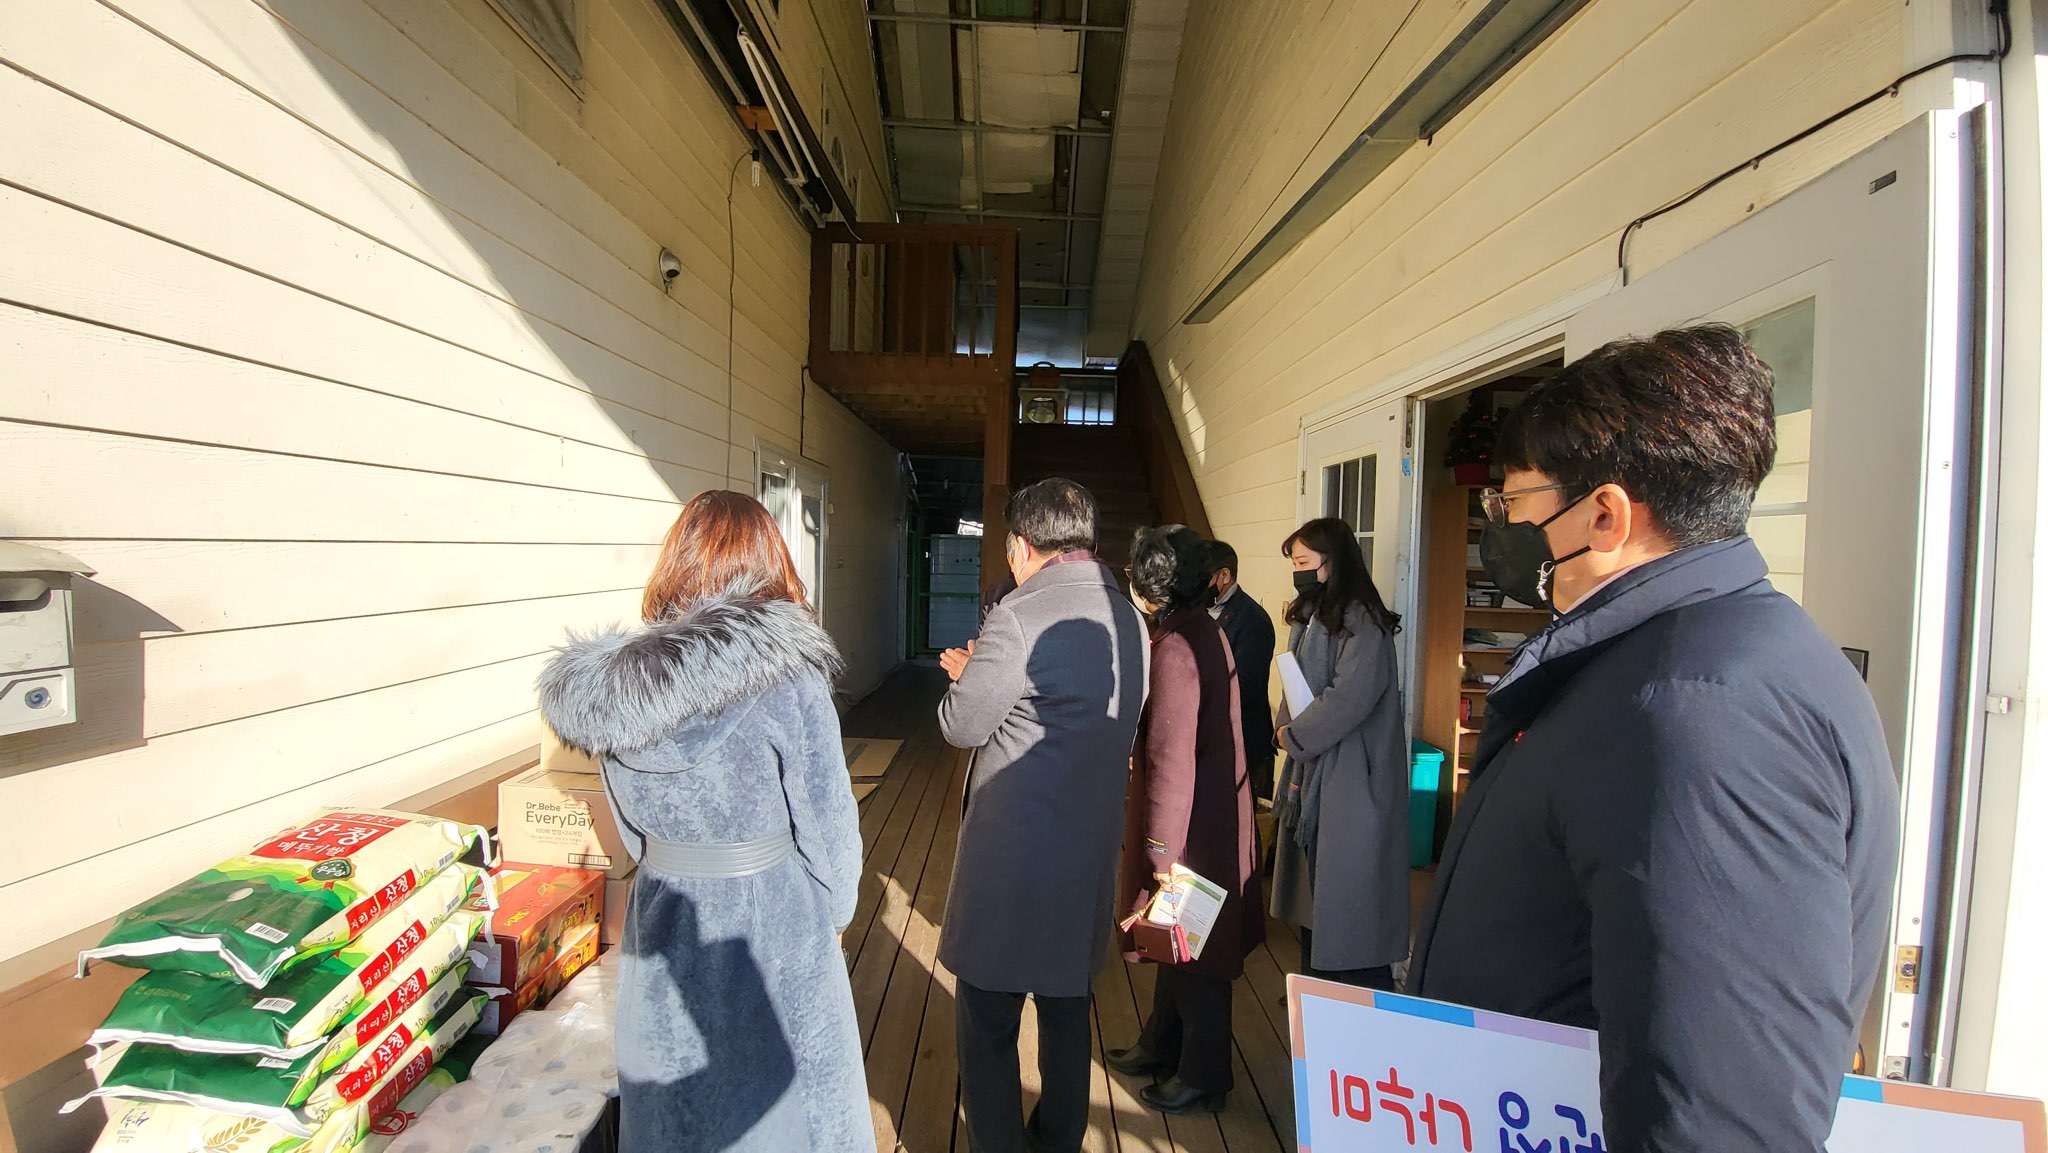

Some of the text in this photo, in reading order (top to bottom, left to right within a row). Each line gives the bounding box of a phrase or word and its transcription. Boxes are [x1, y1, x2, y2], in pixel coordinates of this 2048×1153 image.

[526, 802, 561, 811] Dr.Bebe
[526, 811, 595, 830] EveryDay
[296, 823, 380, 846] 산청
[350, 906, 379, 929] 지리산
[385, 875, 408, 902] 산청
[363, 961, 390, 989] 지리산
[396, 926, 420, 953] 산청
[397, 975, 420, 1003] 산청
[342, 1032, 404, 1098] 지리산 산청
[405, 1053, 426, 1082] 산청
